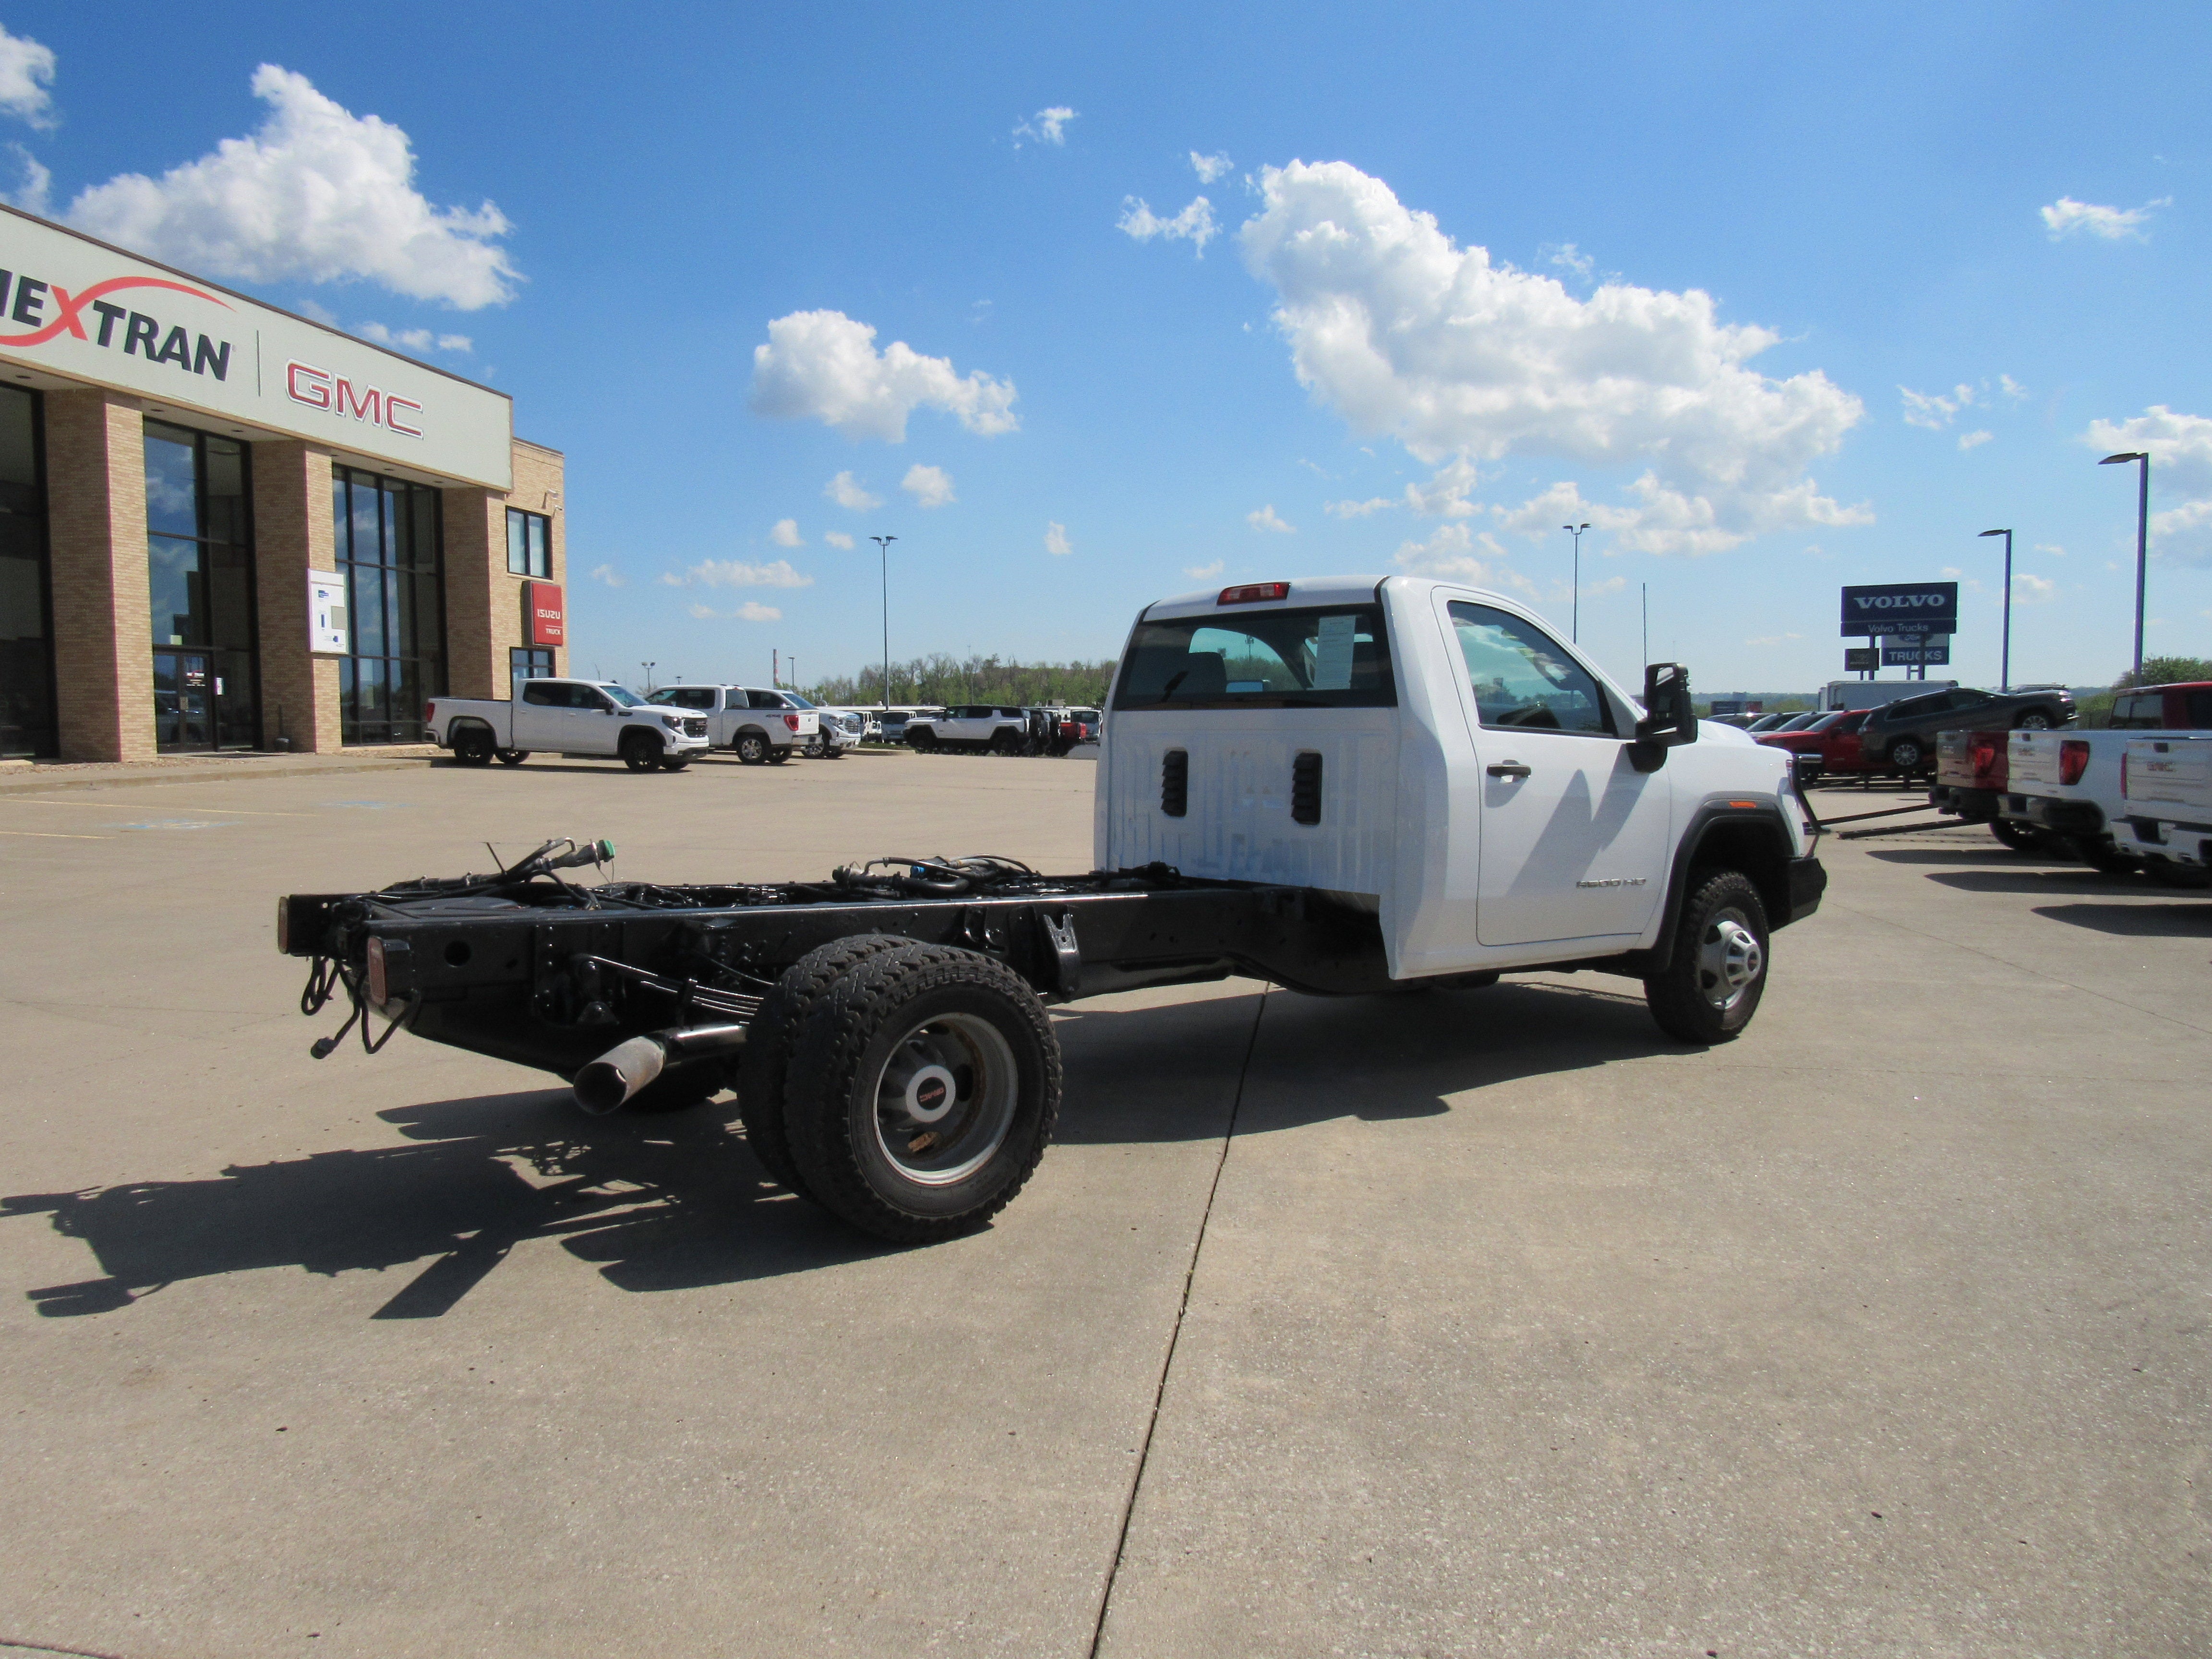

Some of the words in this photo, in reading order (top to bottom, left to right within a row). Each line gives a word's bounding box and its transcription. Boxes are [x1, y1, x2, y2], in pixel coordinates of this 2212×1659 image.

[286, 358, 423, 439] GMC
[1853, 594, 1945, 609] VOLVO
[537, 608, 561, 620] ISUZU
[1867, 624, 1893, 633] Volvo
[1897, 623, 1929, 632] Trucks
